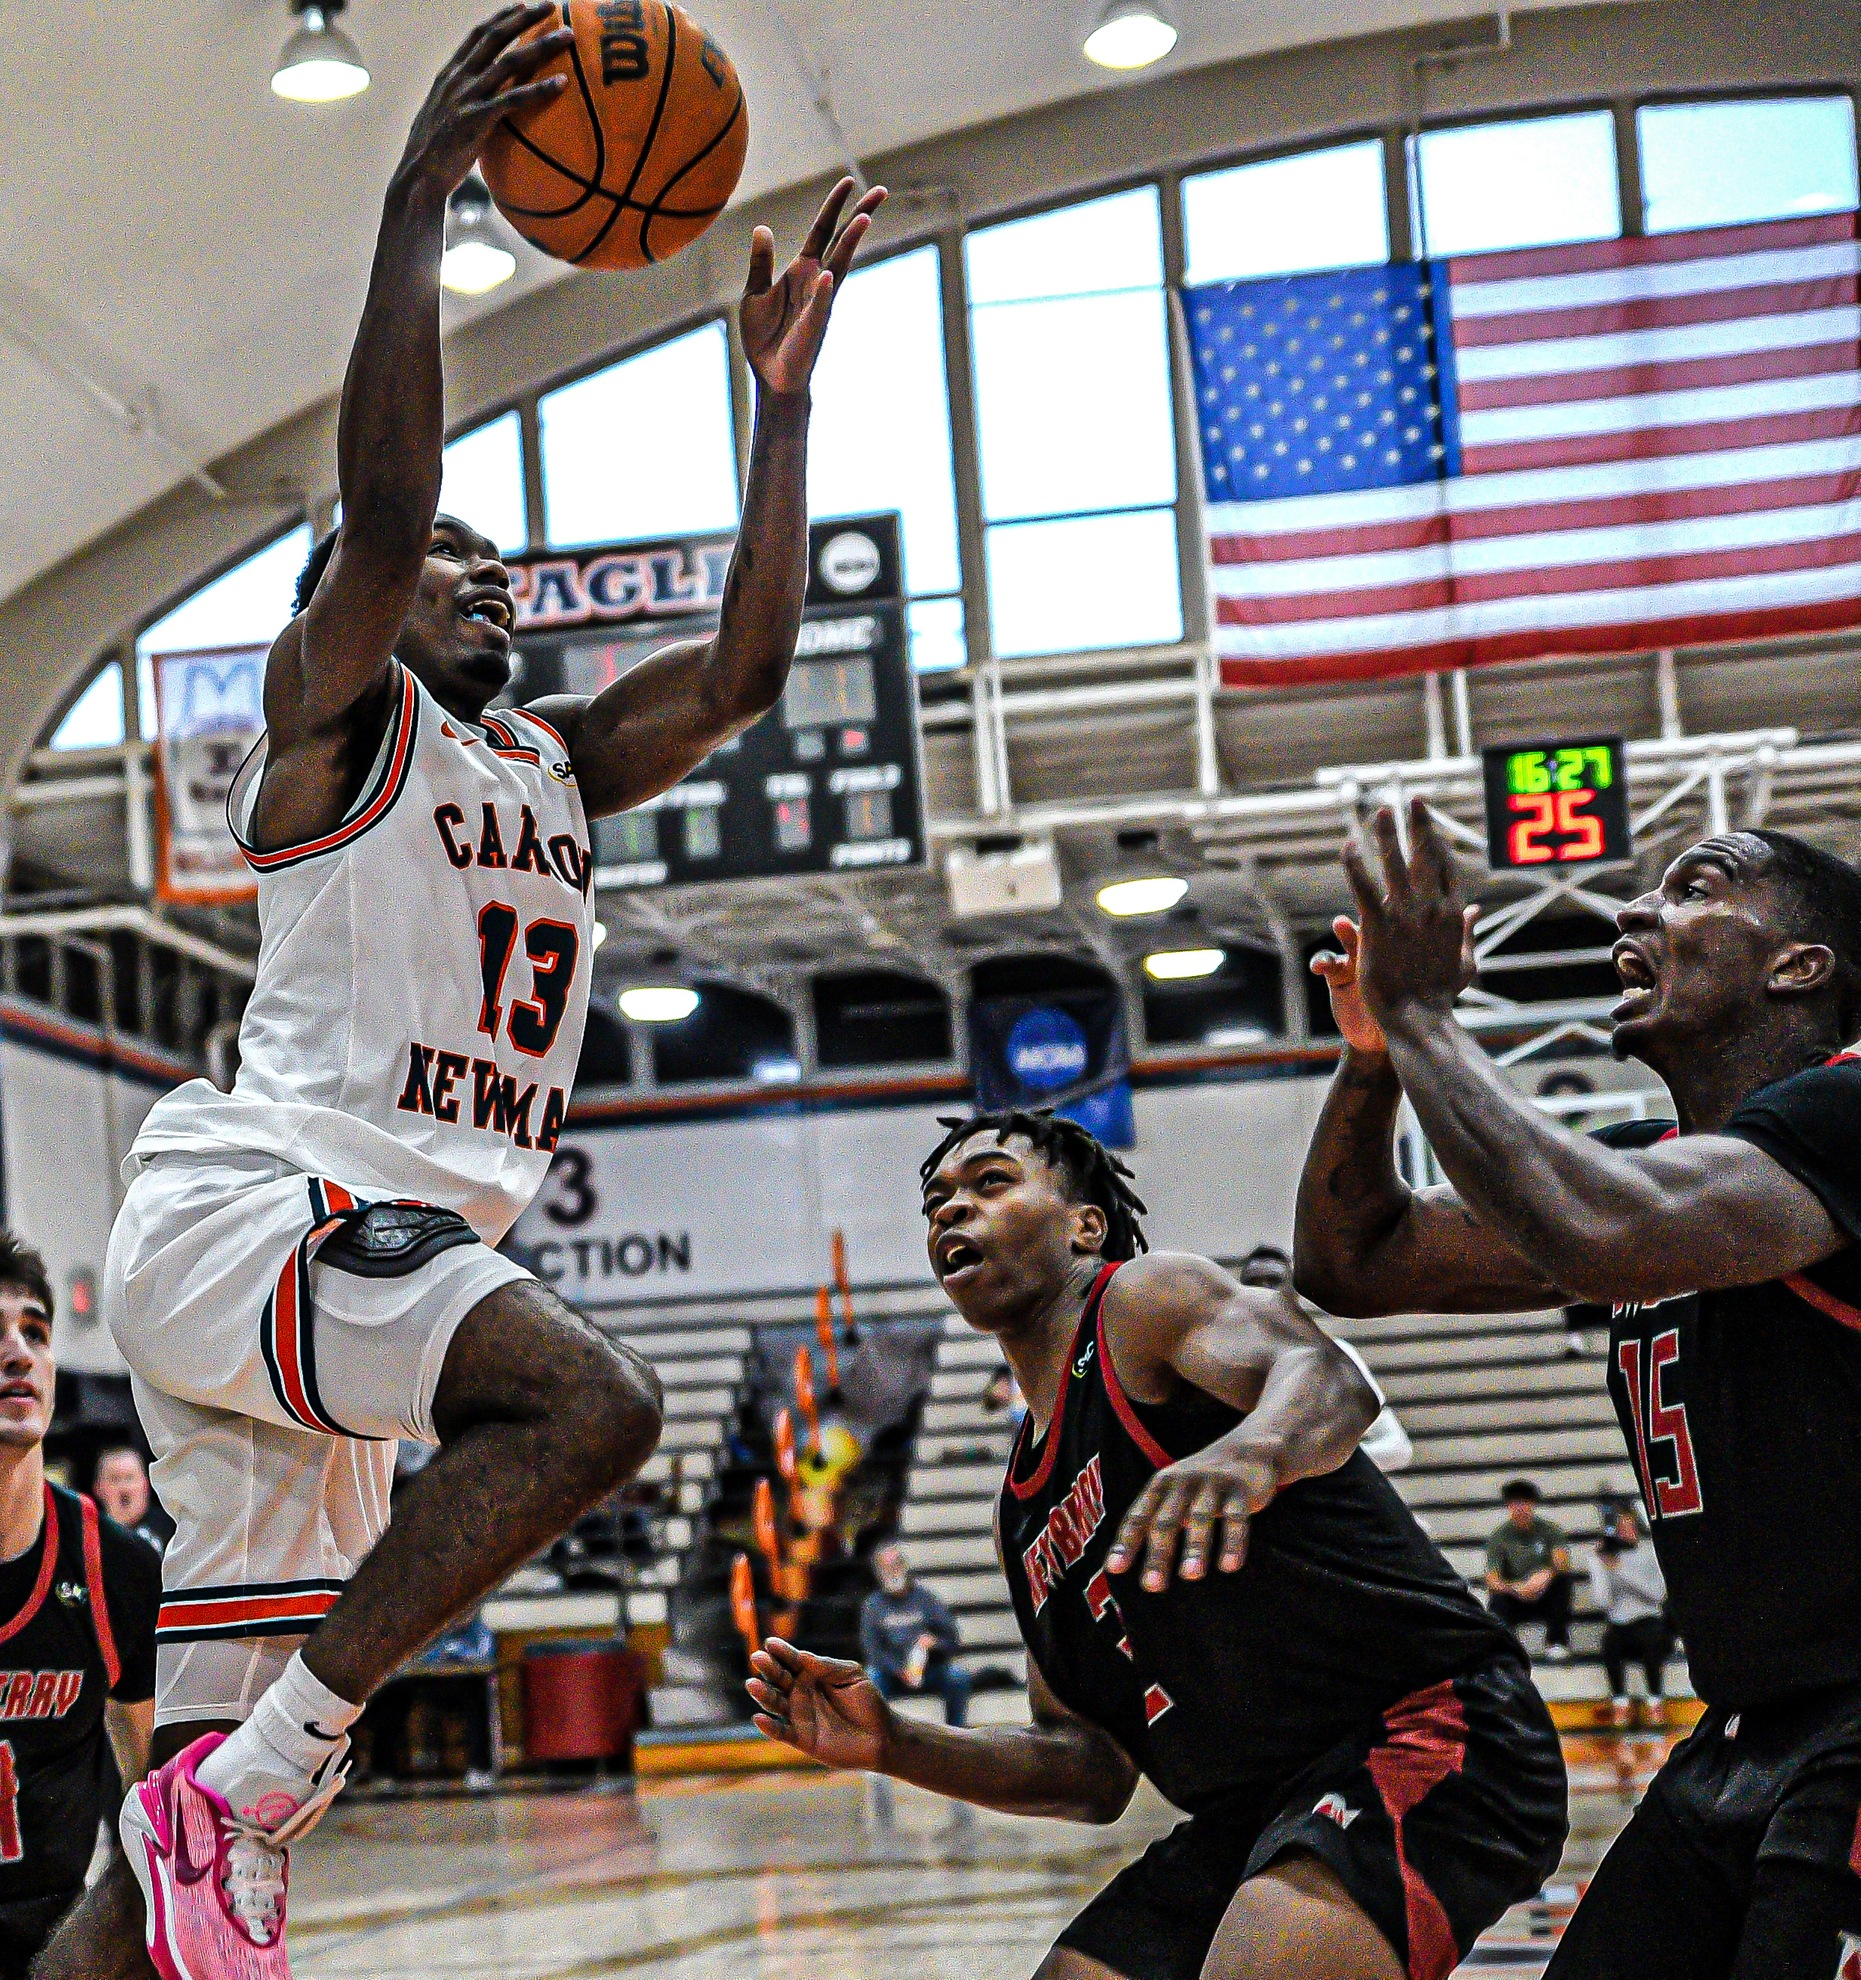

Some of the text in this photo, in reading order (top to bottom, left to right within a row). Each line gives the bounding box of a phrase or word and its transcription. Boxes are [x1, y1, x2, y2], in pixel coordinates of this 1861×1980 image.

[1507, 746, 1612, 794] 16:27
[1508, 788, 1606, 865] 25
[476, 899, 580, 1059] 13
[1618, 1327, 1704, 1521] 15
